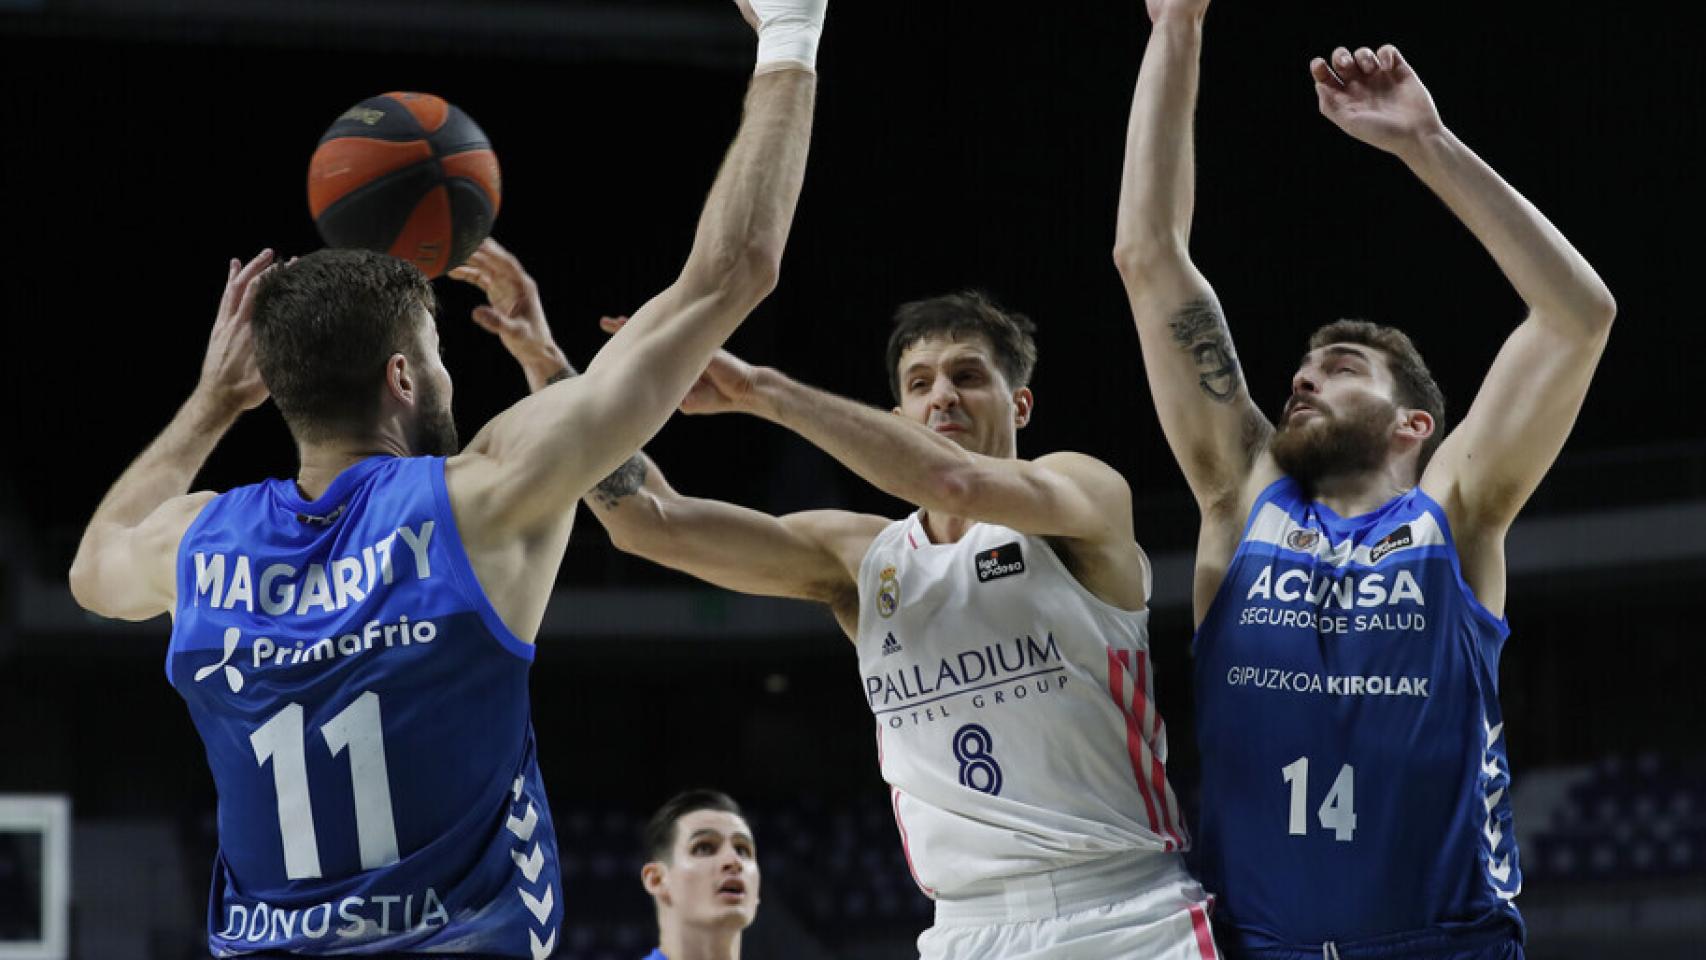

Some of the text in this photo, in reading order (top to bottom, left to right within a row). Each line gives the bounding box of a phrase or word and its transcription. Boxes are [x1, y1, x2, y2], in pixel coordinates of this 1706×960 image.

[193, 520, 435, 616] MAGARITY
[1246, 565, 1425, 610] ACUNSA
[1318, 615, 1349, 634] DE
[1354, 613, 1426, 632] SALUD
[866, 631, 1062, 708] PALLADIUM
[1226, 665, 1430, 697] GIPUZKOA KIROLAK
[888, 675, 1068, 729] OTEL GROUP
[250, 690, 399, 881] 11
[952, 722, 1002, 796] 8
[1281, 755, 1358, 842] 14
[215, 887, 450, 942] DONOSTIA
